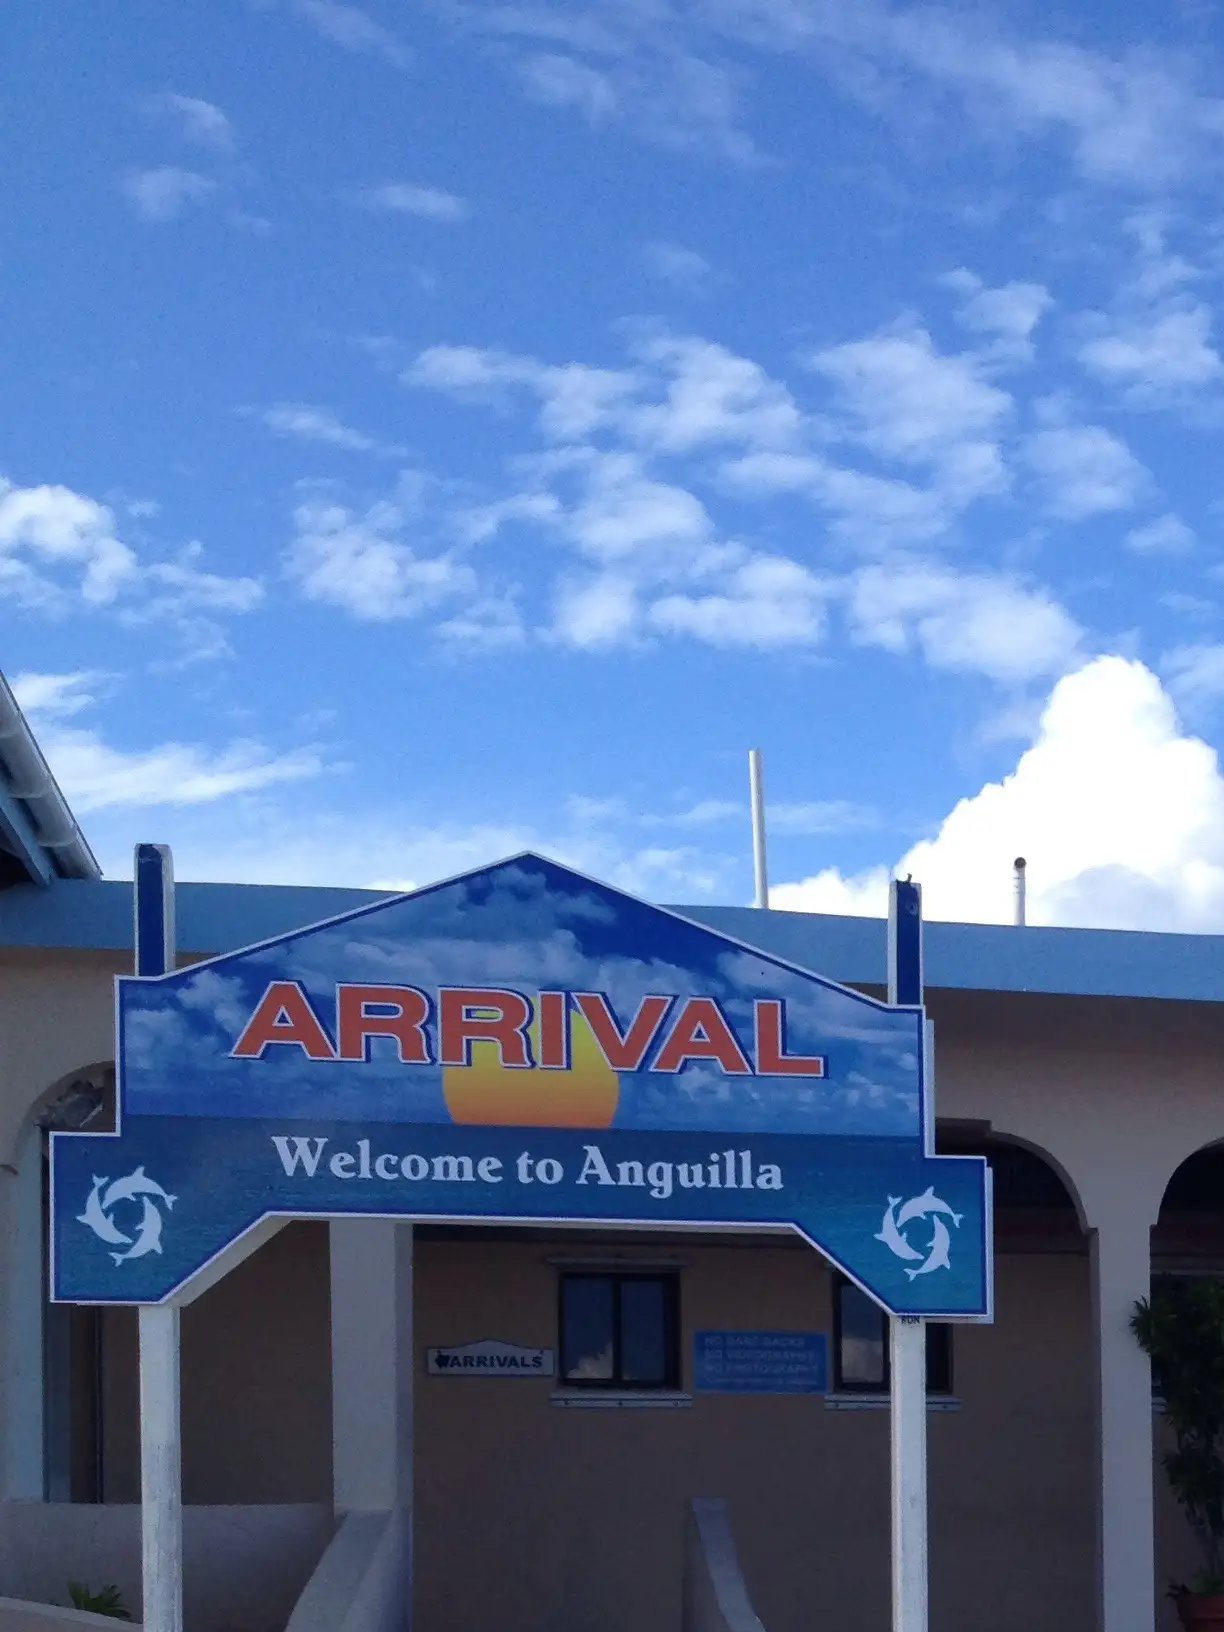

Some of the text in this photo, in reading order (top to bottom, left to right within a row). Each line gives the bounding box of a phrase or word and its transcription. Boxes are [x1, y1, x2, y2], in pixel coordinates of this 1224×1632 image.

[228, 980, 827, 1078] ARRIVAL
[272, 1136, 784, 1198] Welcome to Anguilla
[449, 1355, 543, 1368] ARRIVALS
